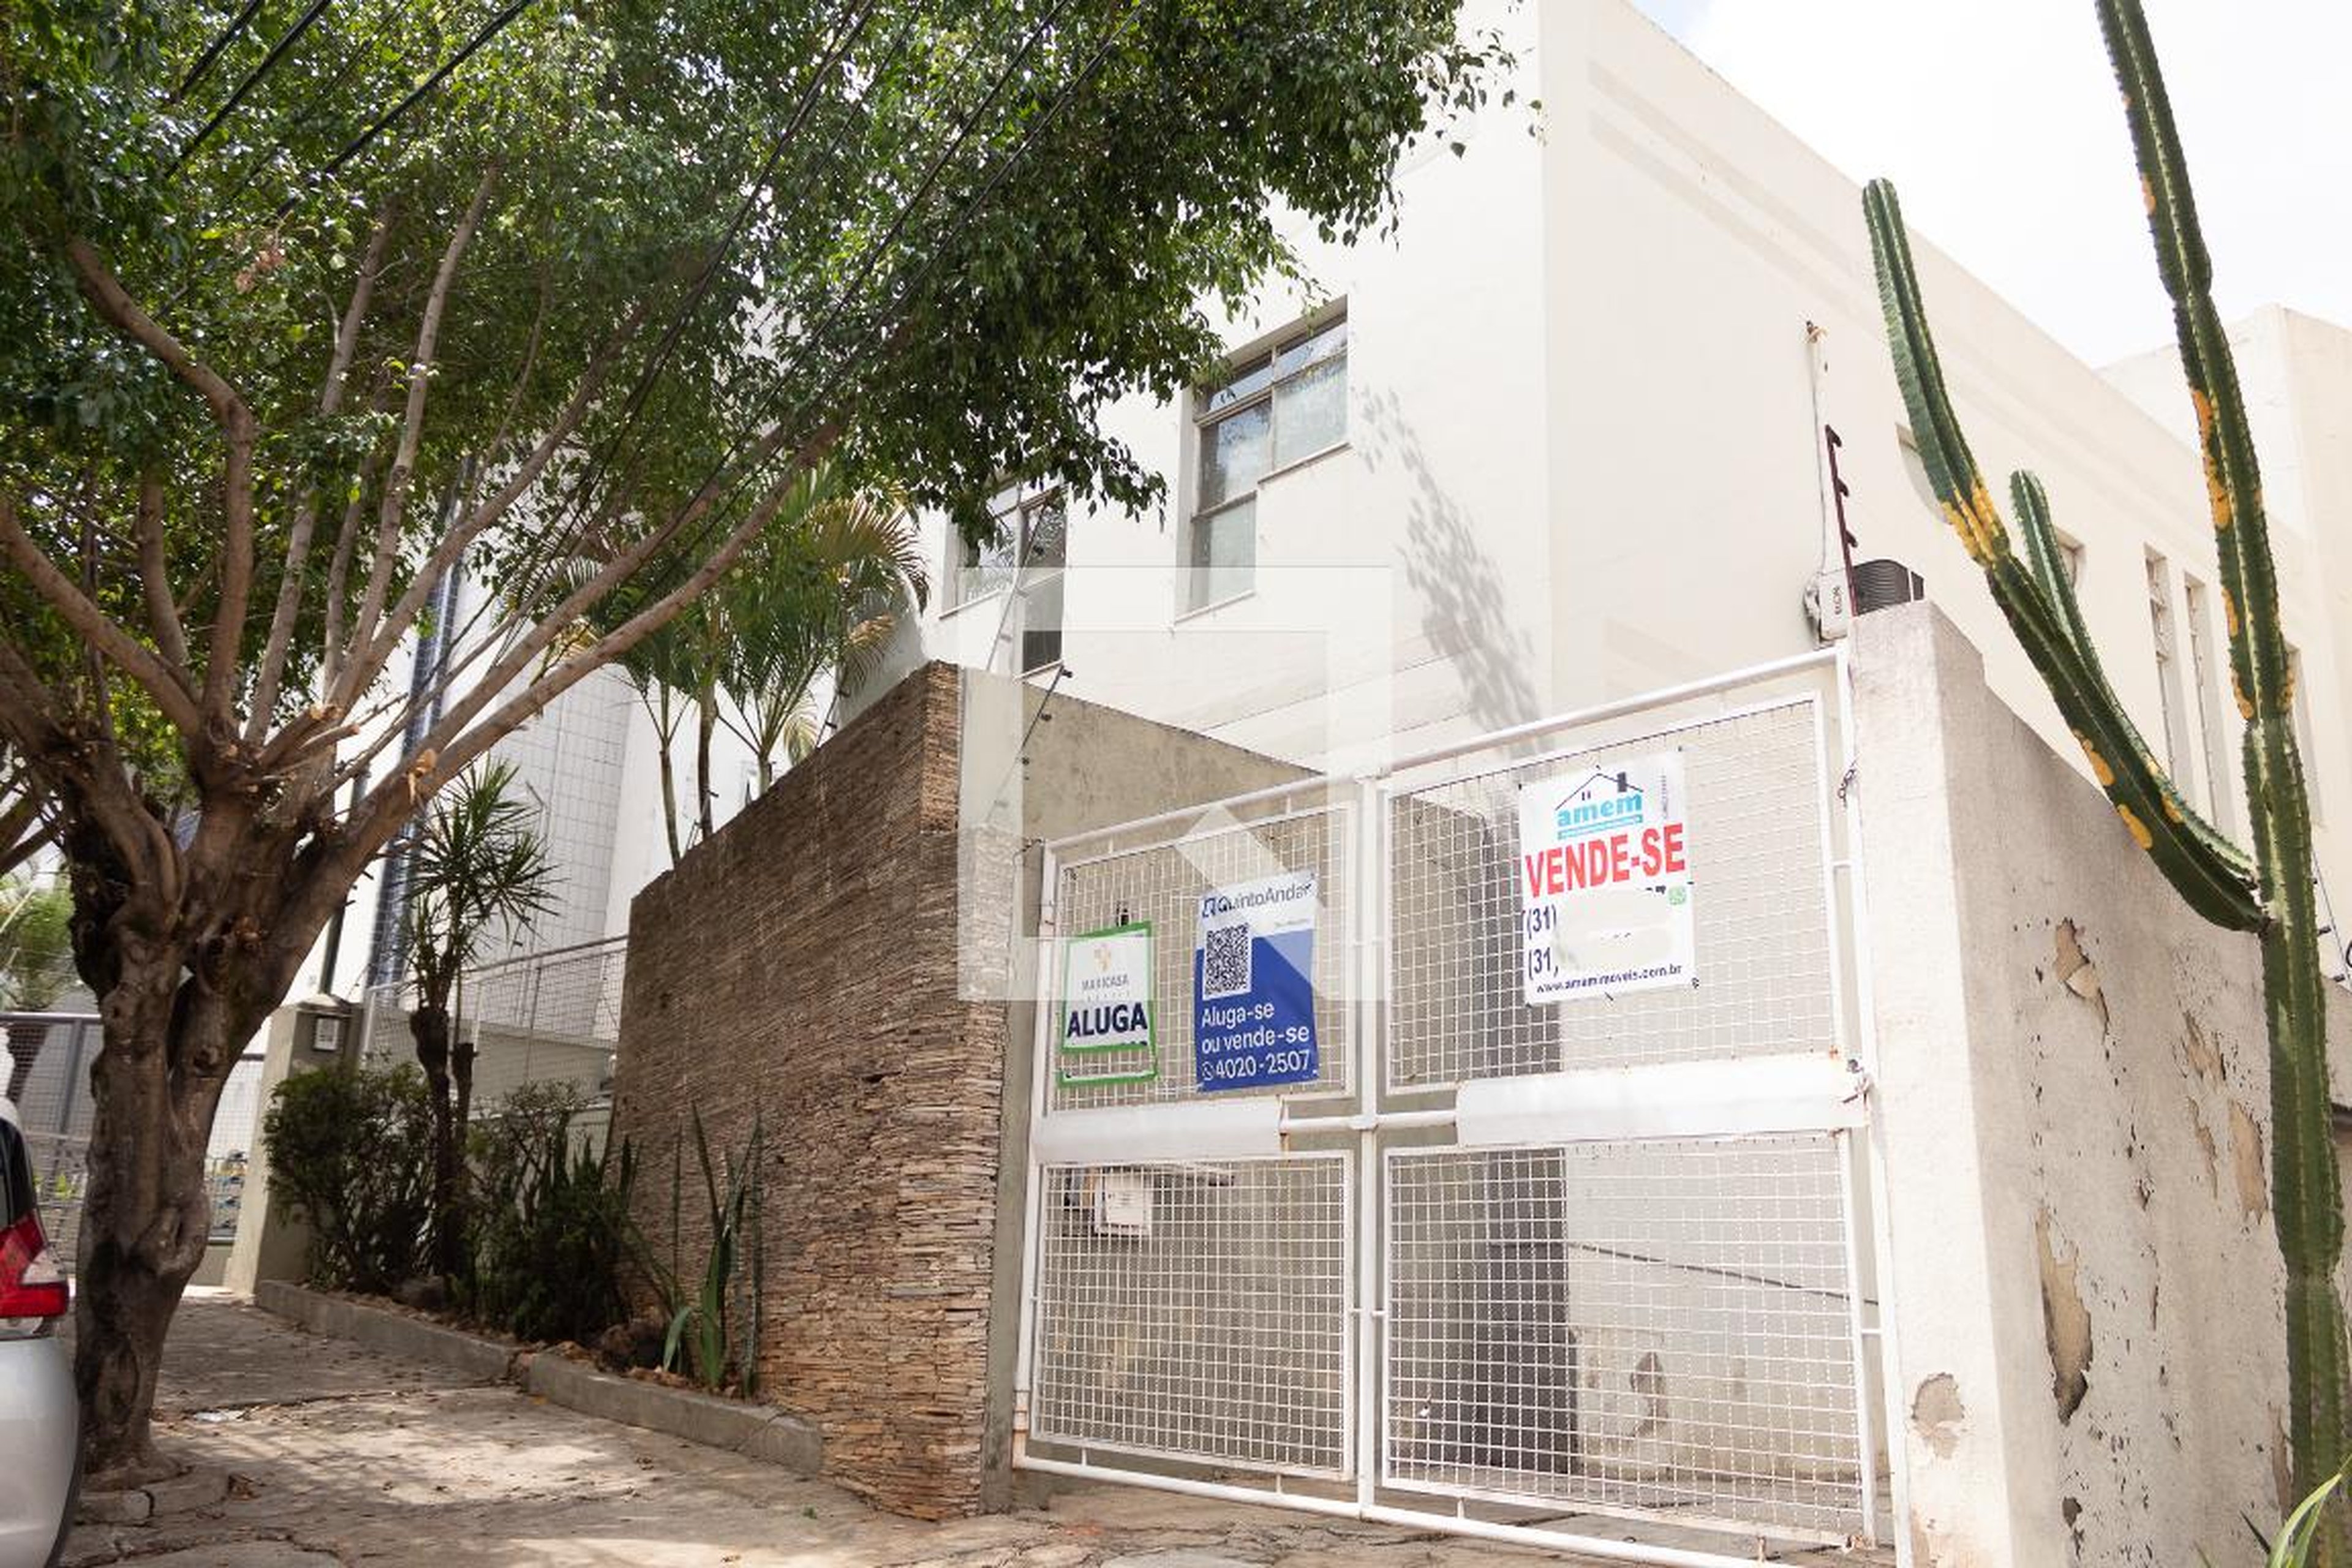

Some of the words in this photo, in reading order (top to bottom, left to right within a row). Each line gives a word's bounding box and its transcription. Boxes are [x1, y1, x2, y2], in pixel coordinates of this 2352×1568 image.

[1558, 793, 1643, 826] amem
[1525, 823, 1686, 898] VENDE-SE
[1218, 883, 1312, 913] QuintoAndar
[1526, 904, 1557, 940] (31)
[1066, 1002, 1148, 1039] ALUGA
[1201, 1000, 1275, 1029] Aluga-se
[1202, 1036, 1221, 1055] ou
[1223, 1023, 1311, 1051] vende-se
[1216, 1049, 1310, 1080] 4020-2507
